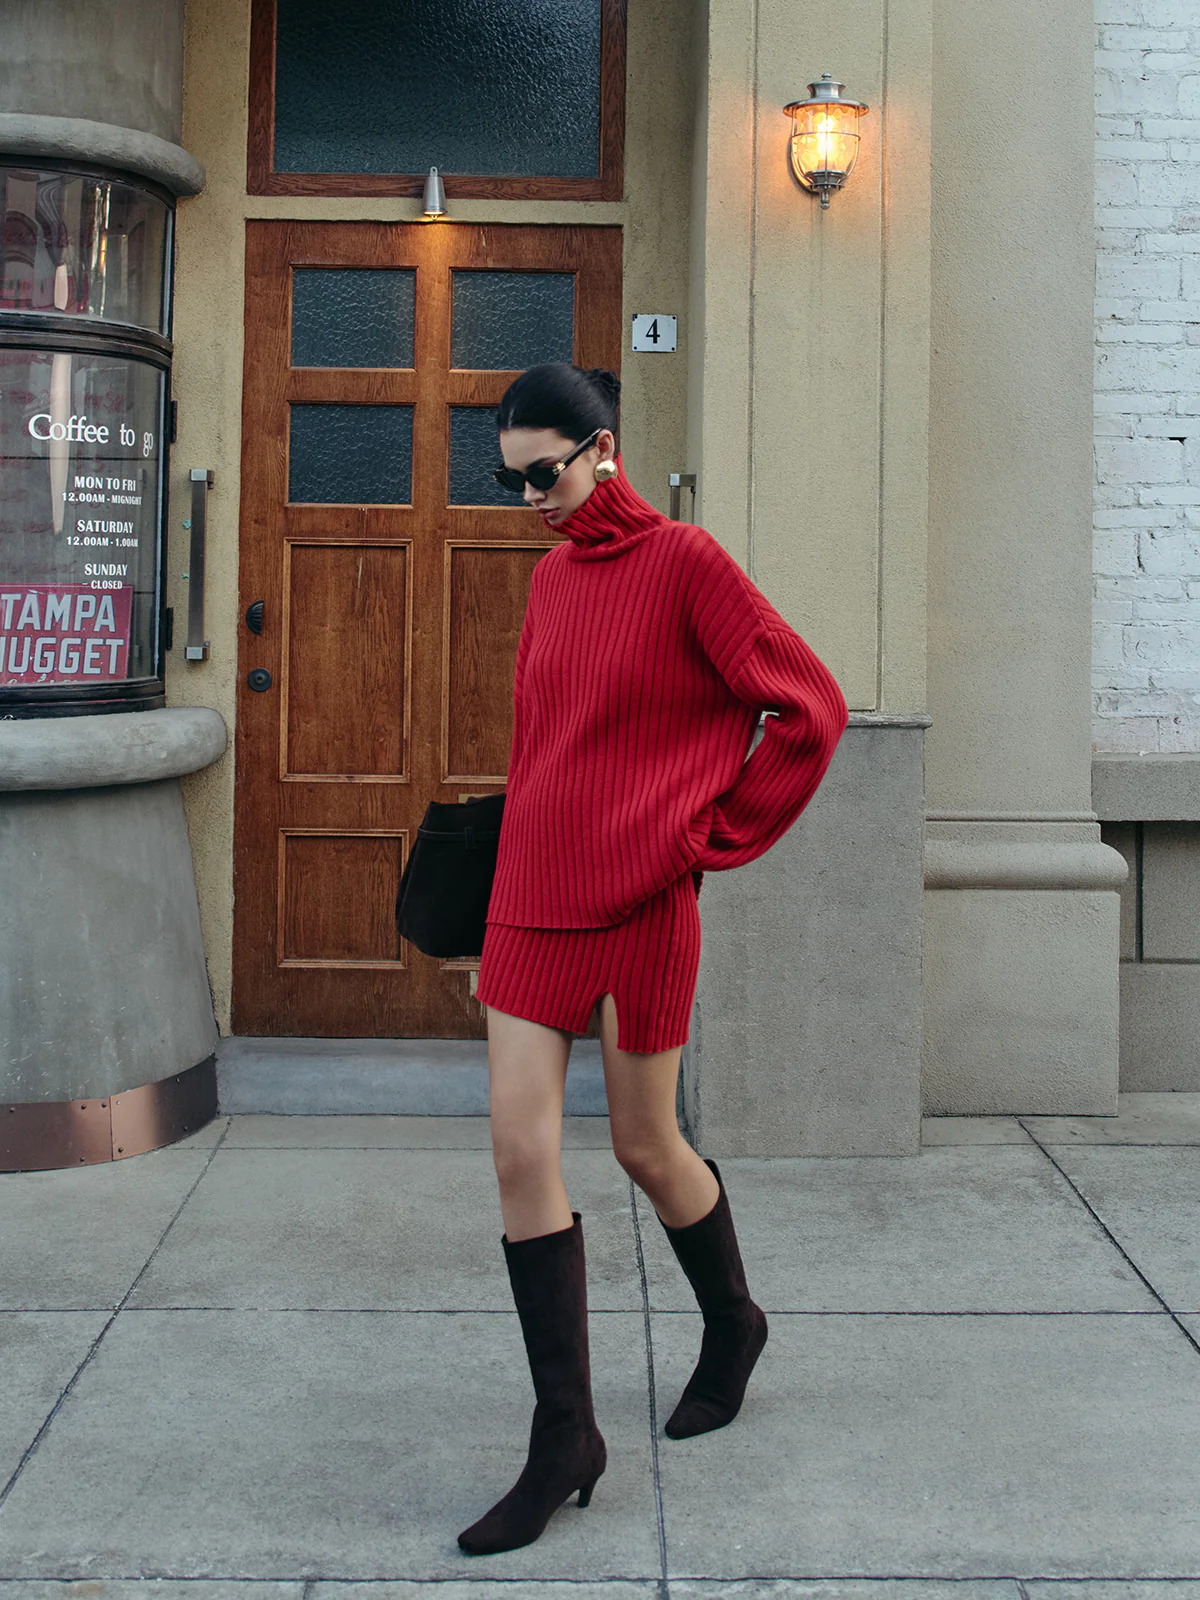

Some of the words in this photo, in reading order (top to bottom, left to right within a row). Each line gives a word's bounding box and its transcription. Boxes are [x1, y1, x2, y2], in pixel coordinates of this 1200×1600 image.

[646, 319, 660, 344] 4
[28, 413, 110, 444] Coffee
[120, 423, 136, 447] to
[143, 432, 154, 457] go
[74, 476, 103, 489] MON
[106, 477, 120, 490] TO
[122, 479, 136, 491] FRI
[62, 492, 105, 503] 12.00AM
[77, 520, 134, 533] SATURDAY
[67, 536, 109, 546] 12.00AM
[115, 538, 139, 547] 1.00AM
[84, 563, 128, 576] SUNDAY
[91, 580, 123, 589] CLOSED
[1, 593, 116, 632] TAMPA
